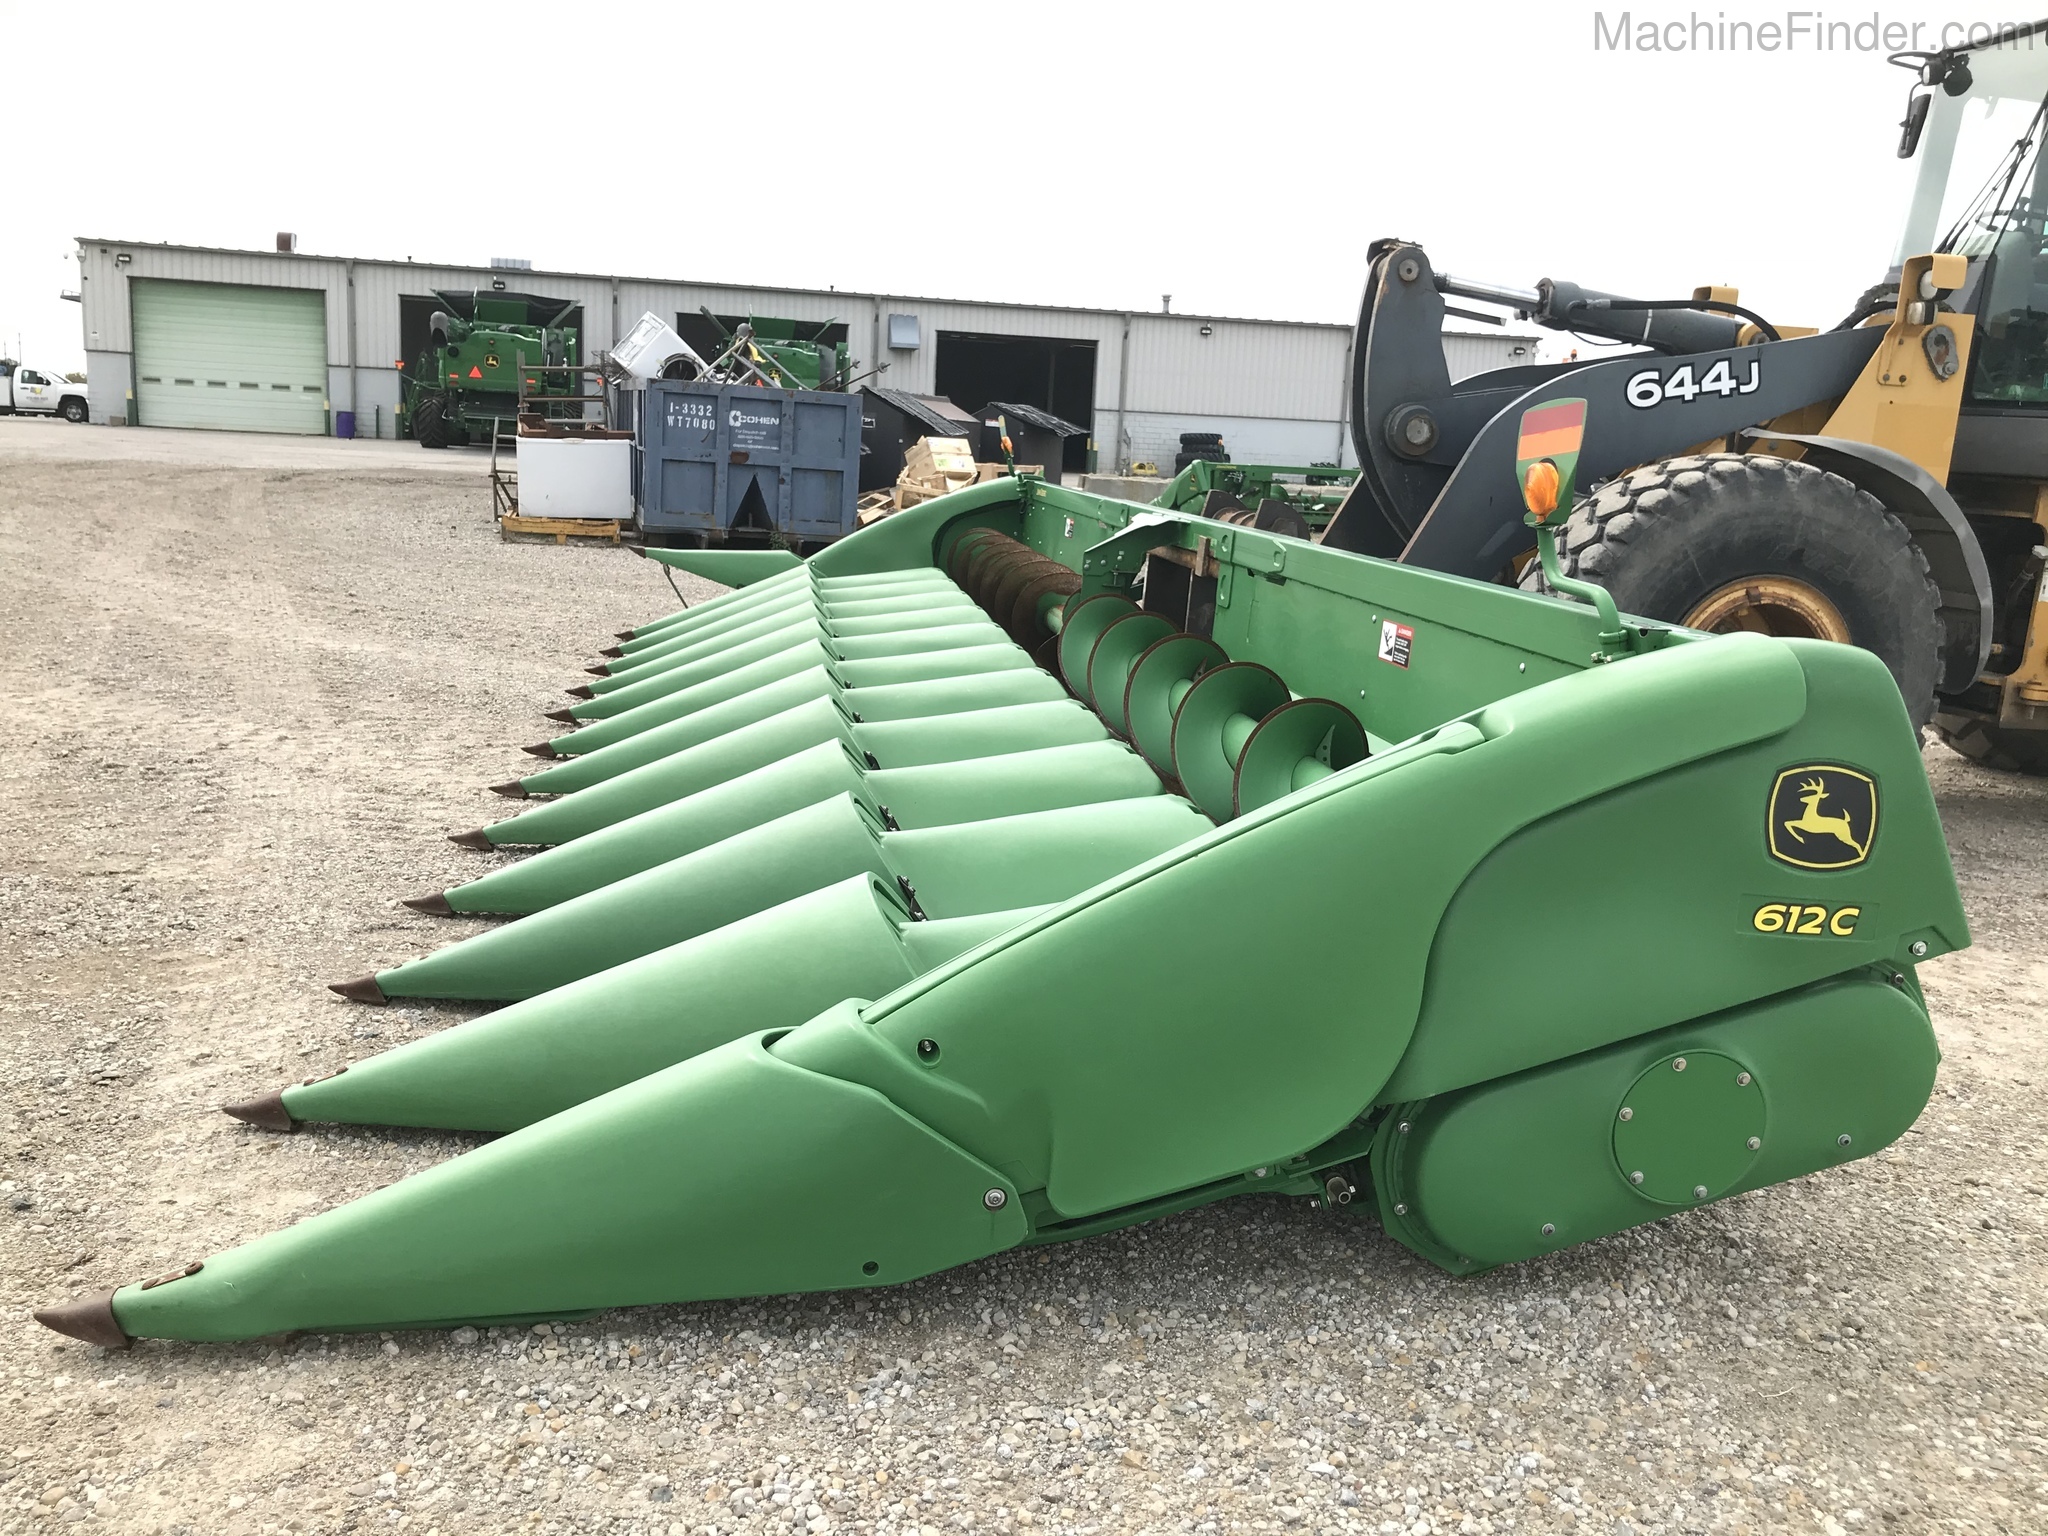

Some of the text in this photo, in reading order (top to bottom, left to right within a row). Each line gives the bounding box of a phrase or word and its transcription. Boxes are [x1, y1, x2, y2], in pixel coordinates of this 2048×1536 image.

[1626, 359, 1760, 408] 644J
[667, 415, 716, 430] WT7080
[738, 415, 780, 425] COHEN
[1753, 903, 1862, 936] 612C
